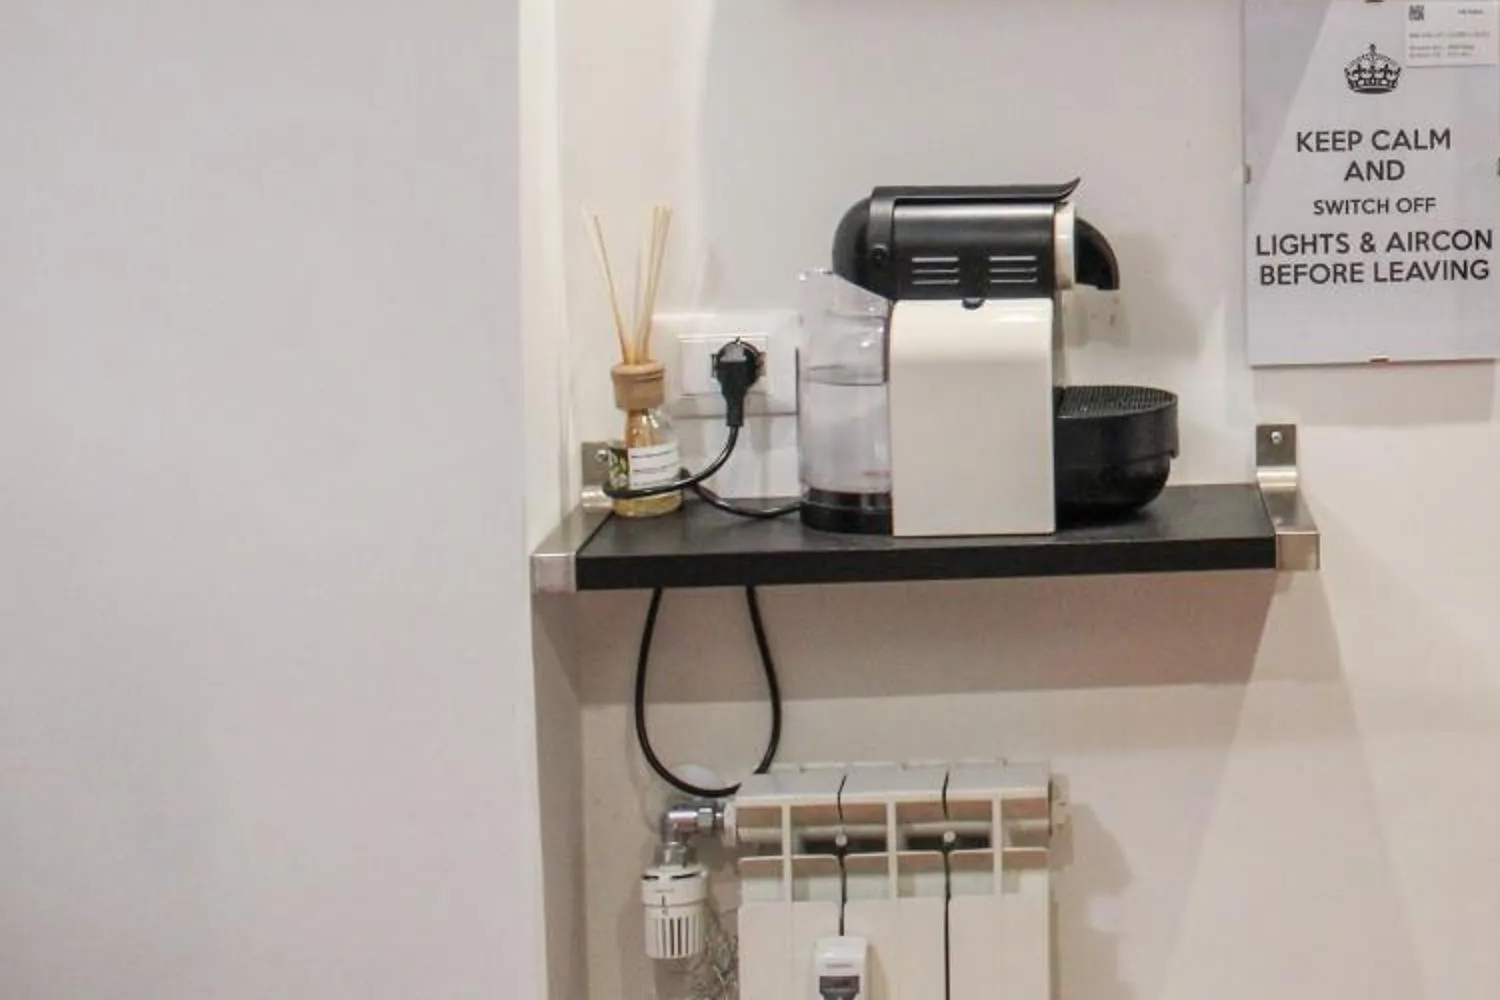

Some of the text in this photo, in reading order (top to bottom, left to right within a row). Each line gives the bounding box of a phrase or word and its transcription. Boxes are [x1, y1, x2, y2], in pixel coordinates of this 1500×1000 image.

[1296, 127, 1451, 152] KEEP CALM
[1344, 159, 1405, 182] AND
[1313, 197, 1436, 215] SWITCH OFF
[1256, 229, 1493, 257] LIGHTS & AIRCON
[1260, 259, 1490, 286] BEFORE LEAVING
